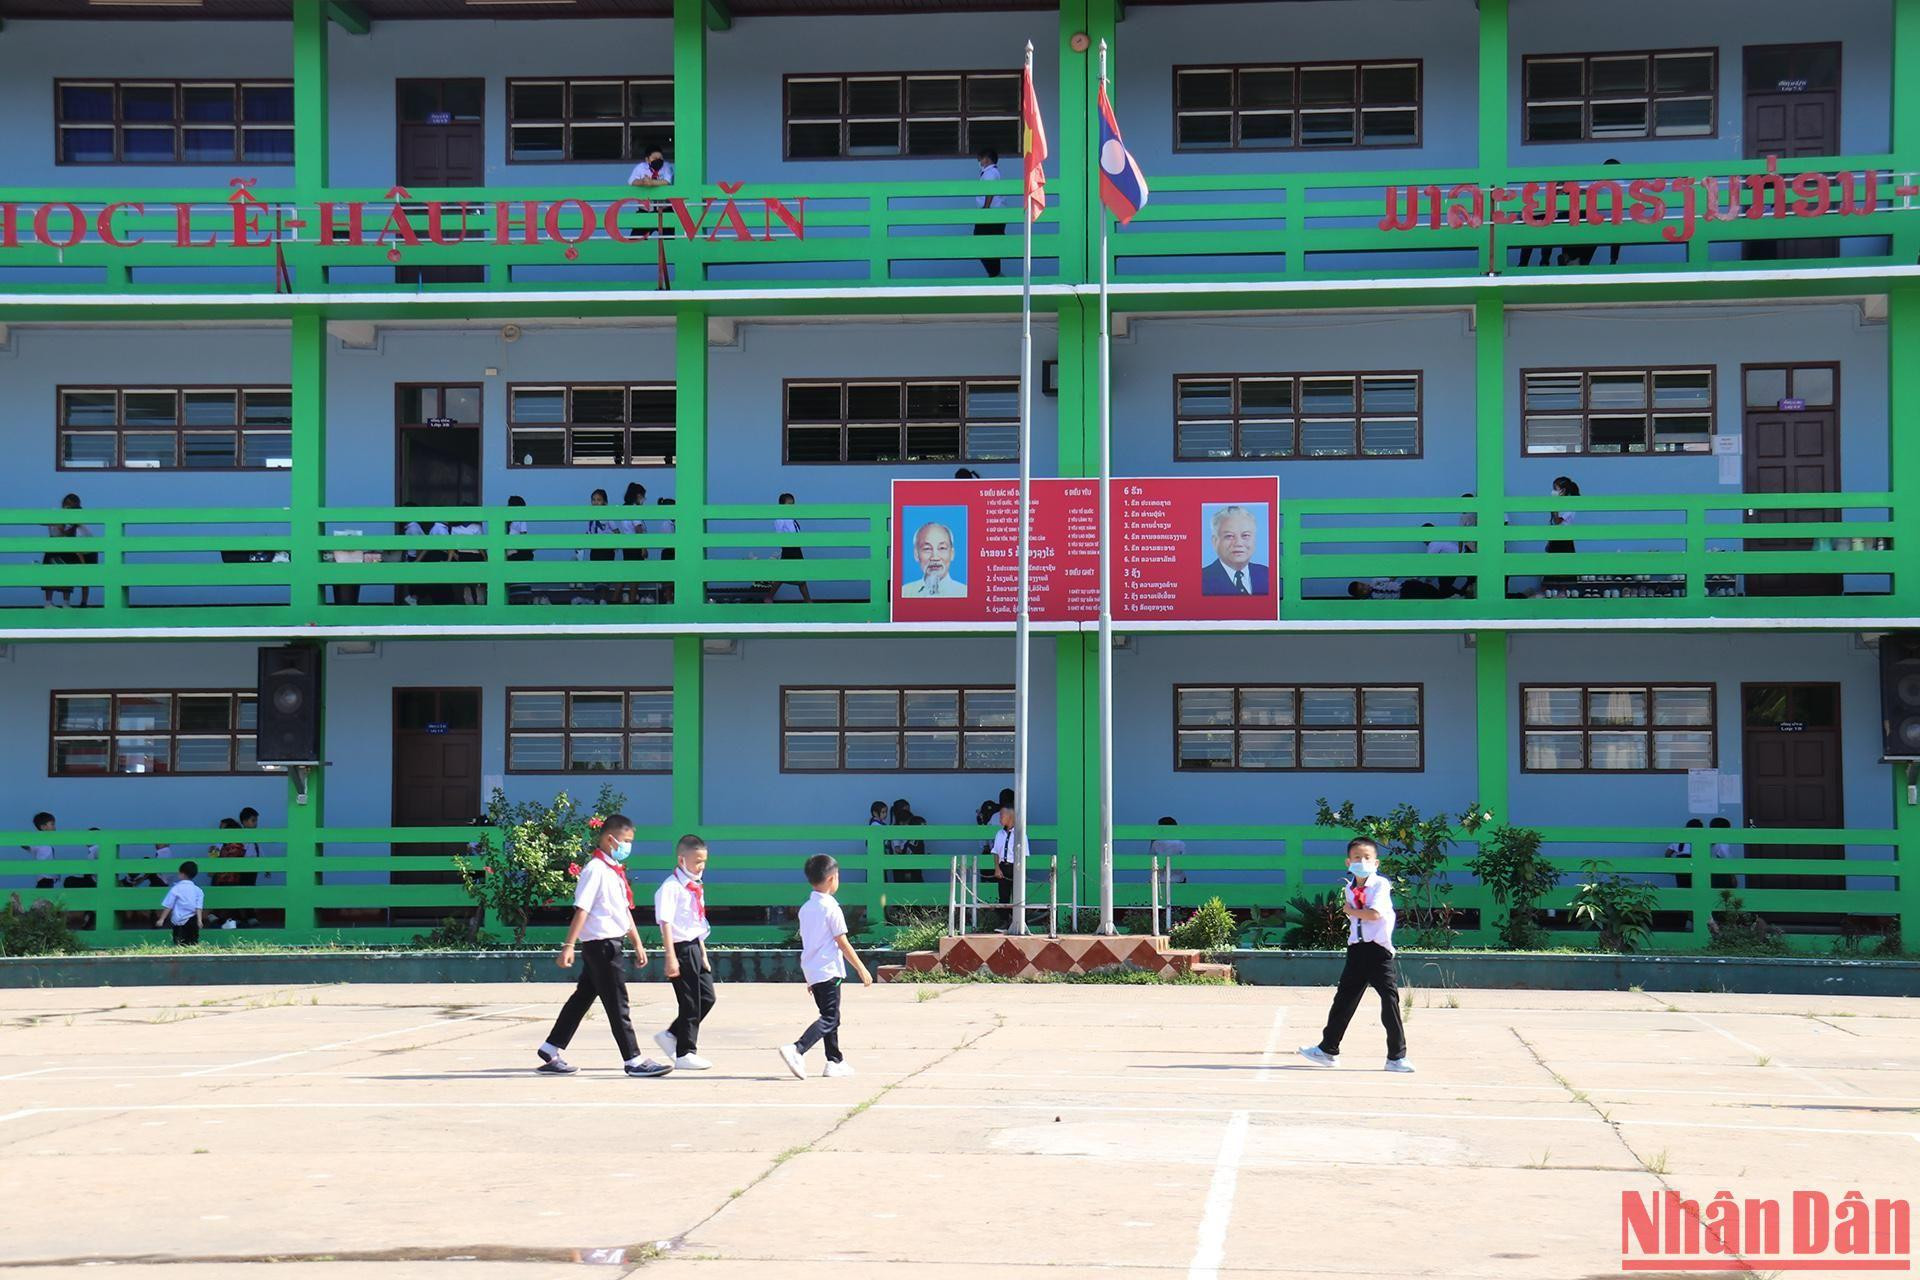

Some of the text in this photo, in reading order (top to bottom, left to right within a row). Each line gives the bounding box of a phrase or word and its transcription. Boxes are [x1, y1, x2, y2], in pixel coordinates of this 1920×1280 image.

[173, 178, 272, 248] LỄ
[315, 186, 471, 262] HẬU
[492, 198, 651, 260] HỌC
[669, 181, 809, 242] VĂN
[1124, 487, 1129, 495] 6
